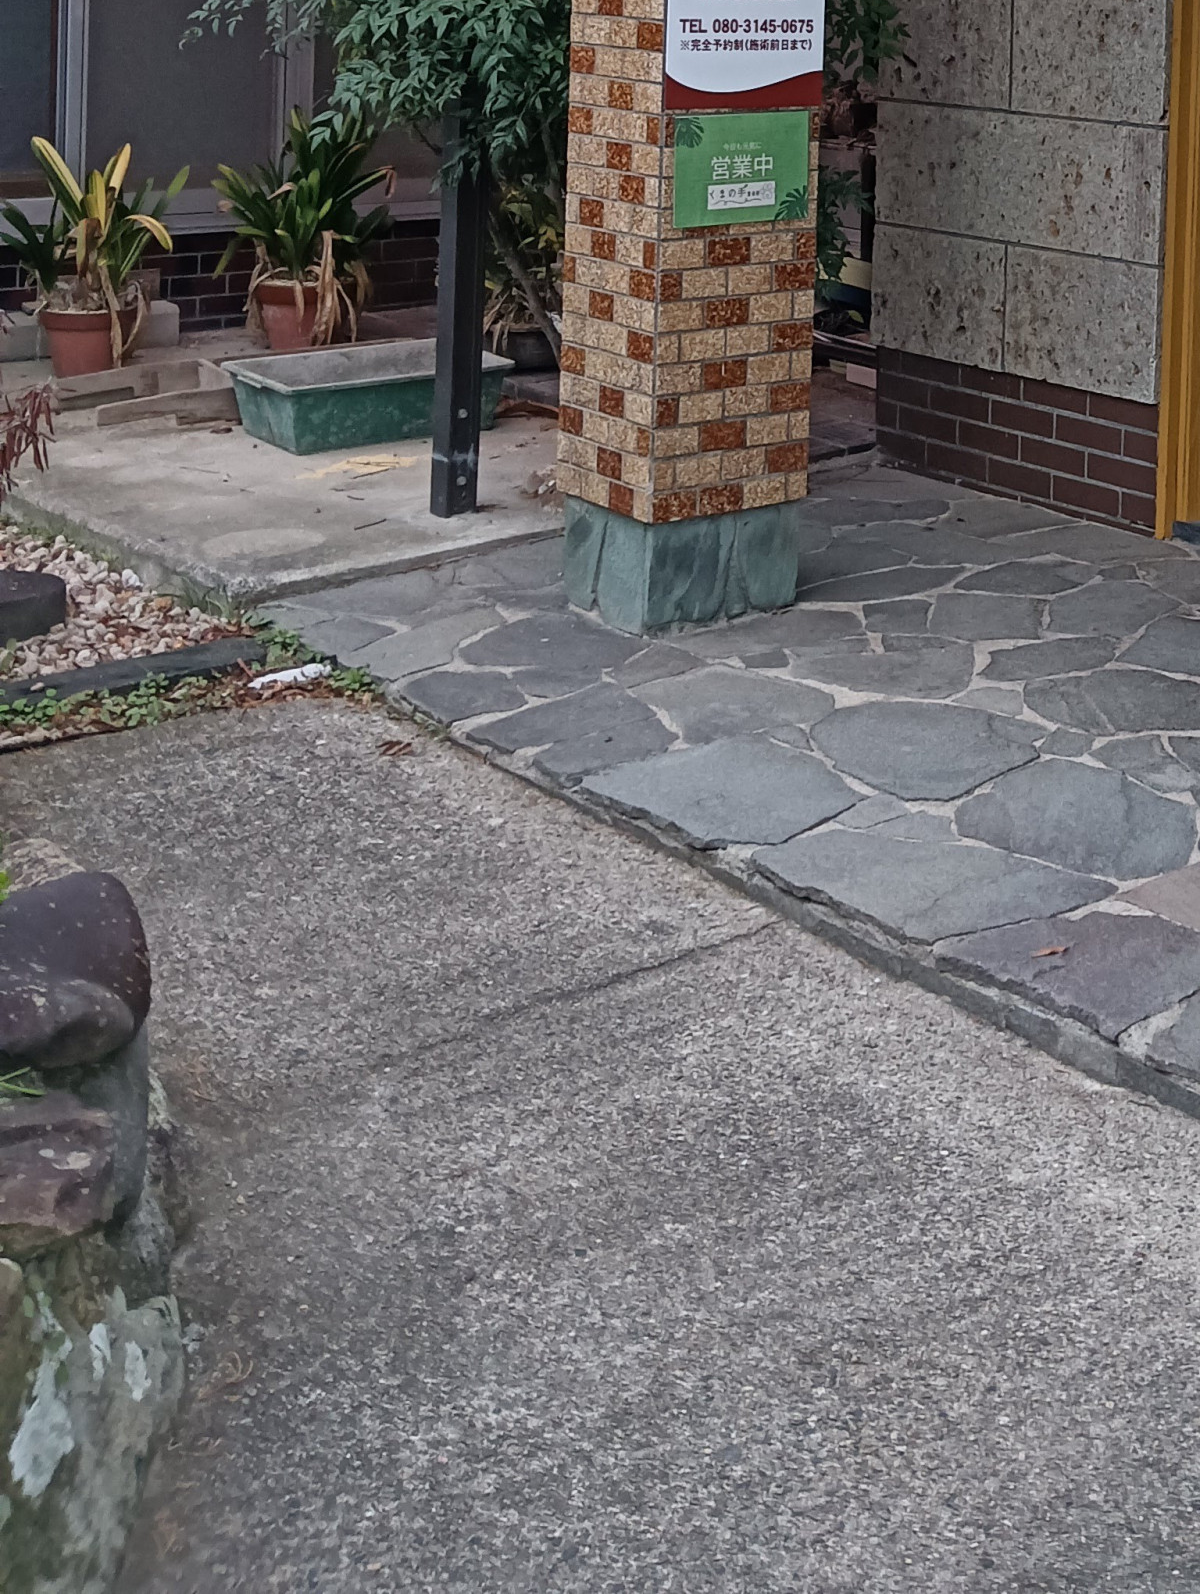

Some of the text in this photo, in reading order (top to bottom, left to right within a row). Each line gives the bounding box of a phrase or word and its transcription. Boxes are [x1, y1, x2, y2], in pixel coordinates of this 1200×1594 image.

[679, 18, 815, 34] TEL 080-3145-0675
[711, 152, 774, 181] 営業中
